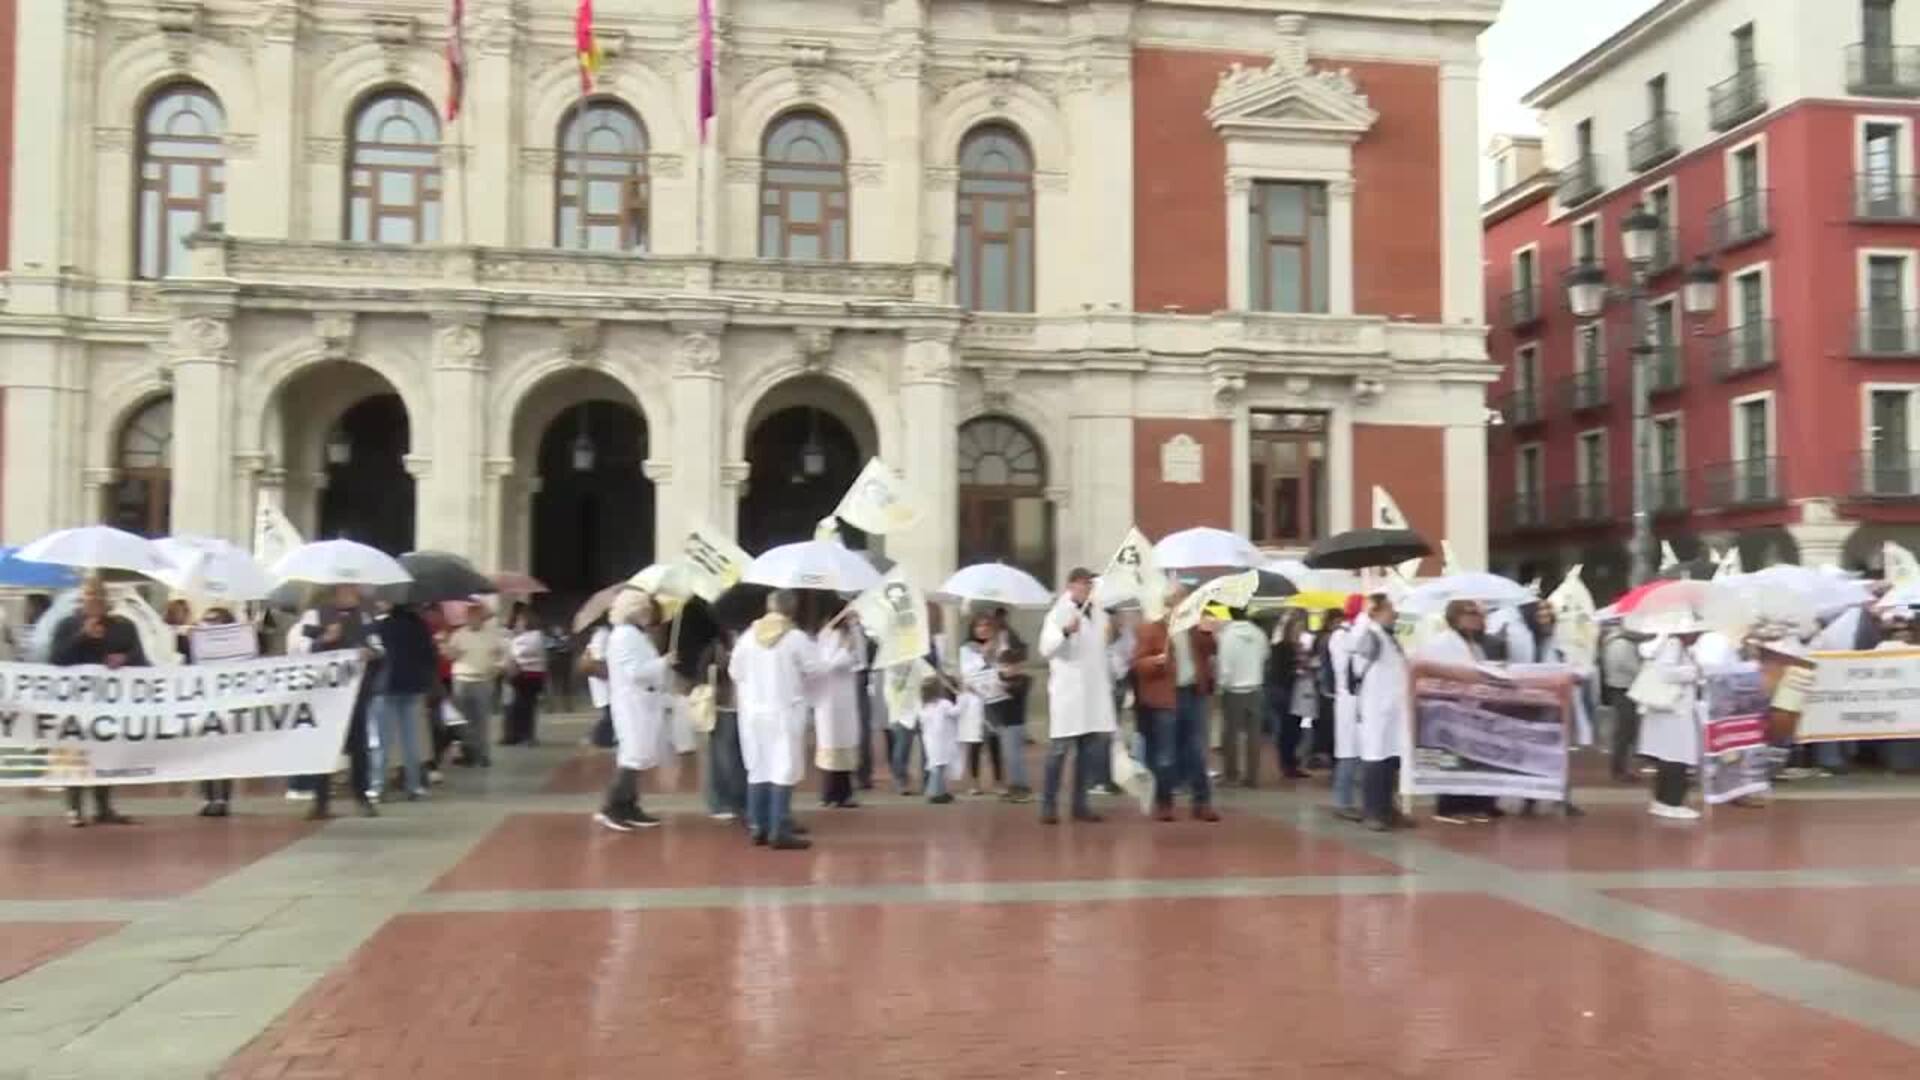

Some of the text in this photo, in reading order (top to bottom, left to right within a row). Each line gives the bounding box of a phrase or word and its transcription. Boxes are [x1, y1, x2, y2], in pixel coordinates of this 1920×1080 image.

[133, 678, 166, 703] DE
[176, 675, 205, 701] LA
[35, 702, 318, 742] FACULTATIVA
